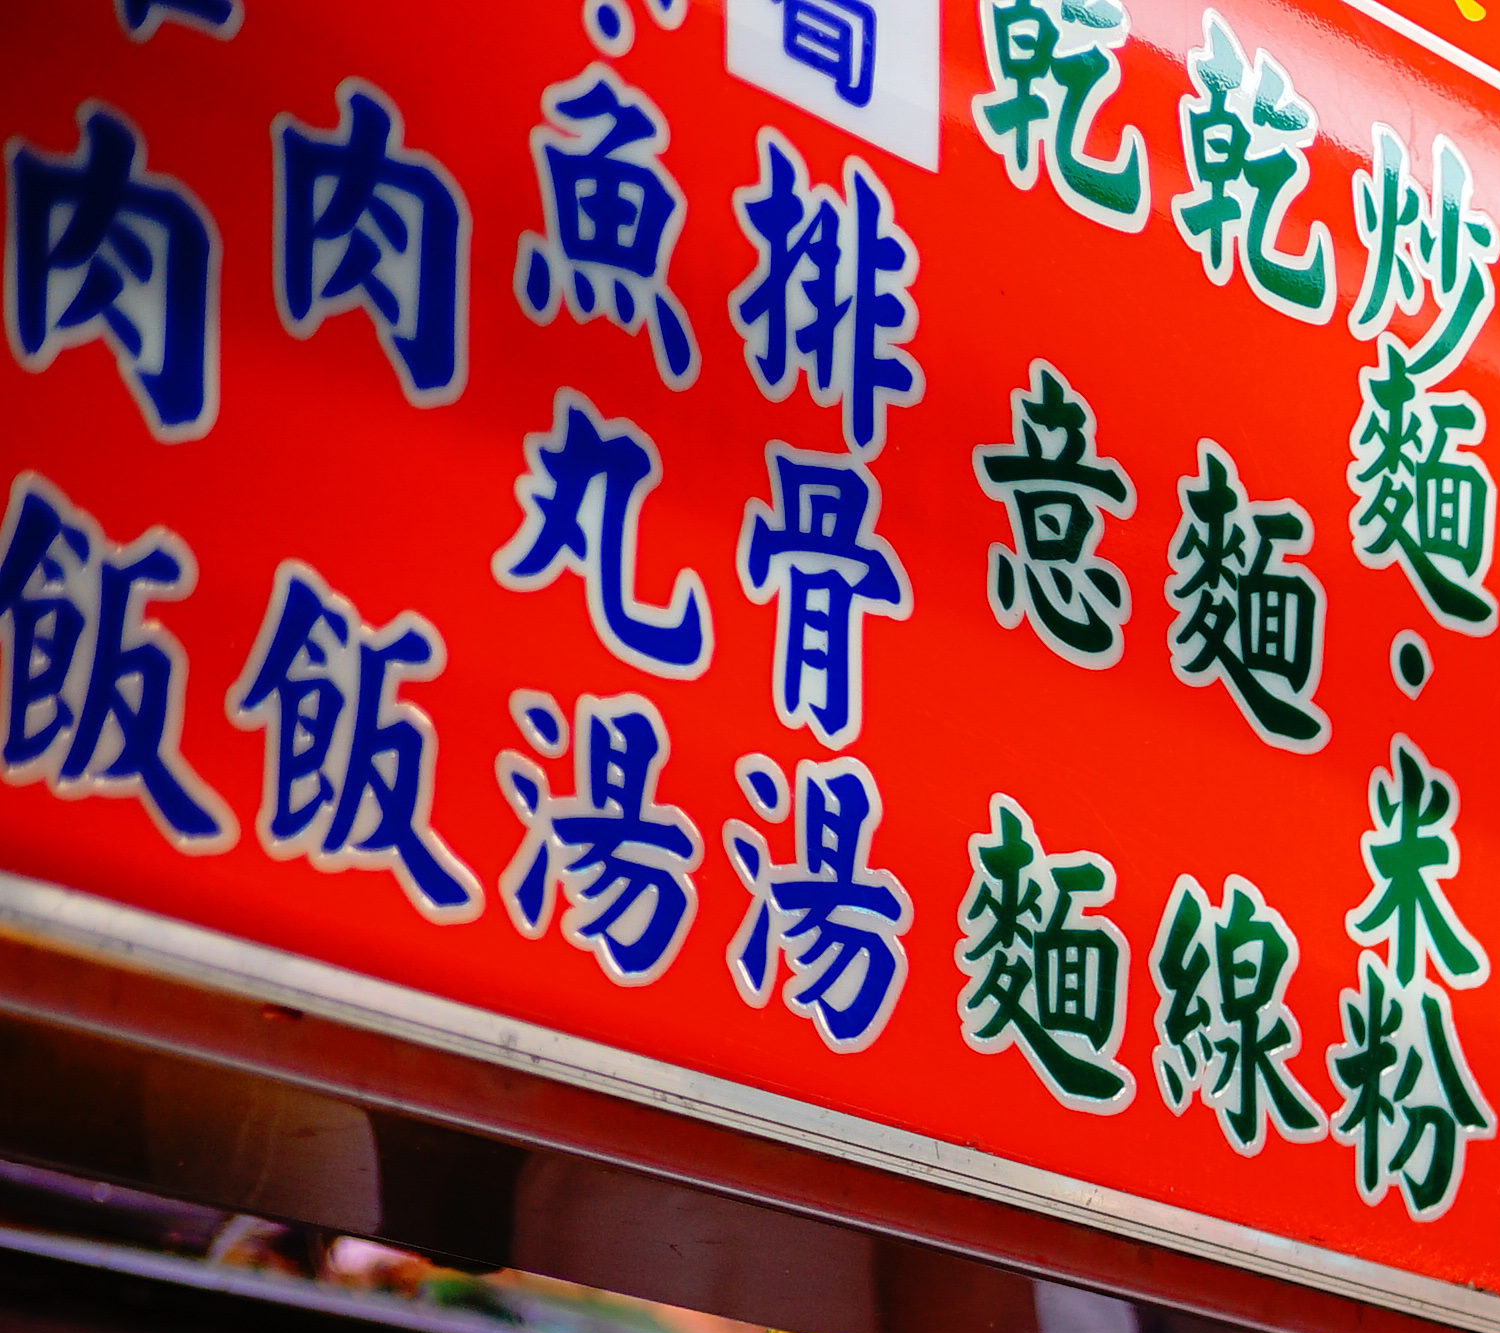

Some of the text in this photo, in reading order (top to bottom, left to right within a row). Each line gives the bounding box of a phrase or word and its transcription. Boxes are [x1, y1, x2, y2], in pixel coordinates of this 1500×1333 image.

[0, 0, 240, 855] 肉飯
[495, 0, 715, 982] 魚丸湯
[956, 0, 1149, 1112] 乾意麵
[1149, 8, 1336, 1158] 乾麵線
